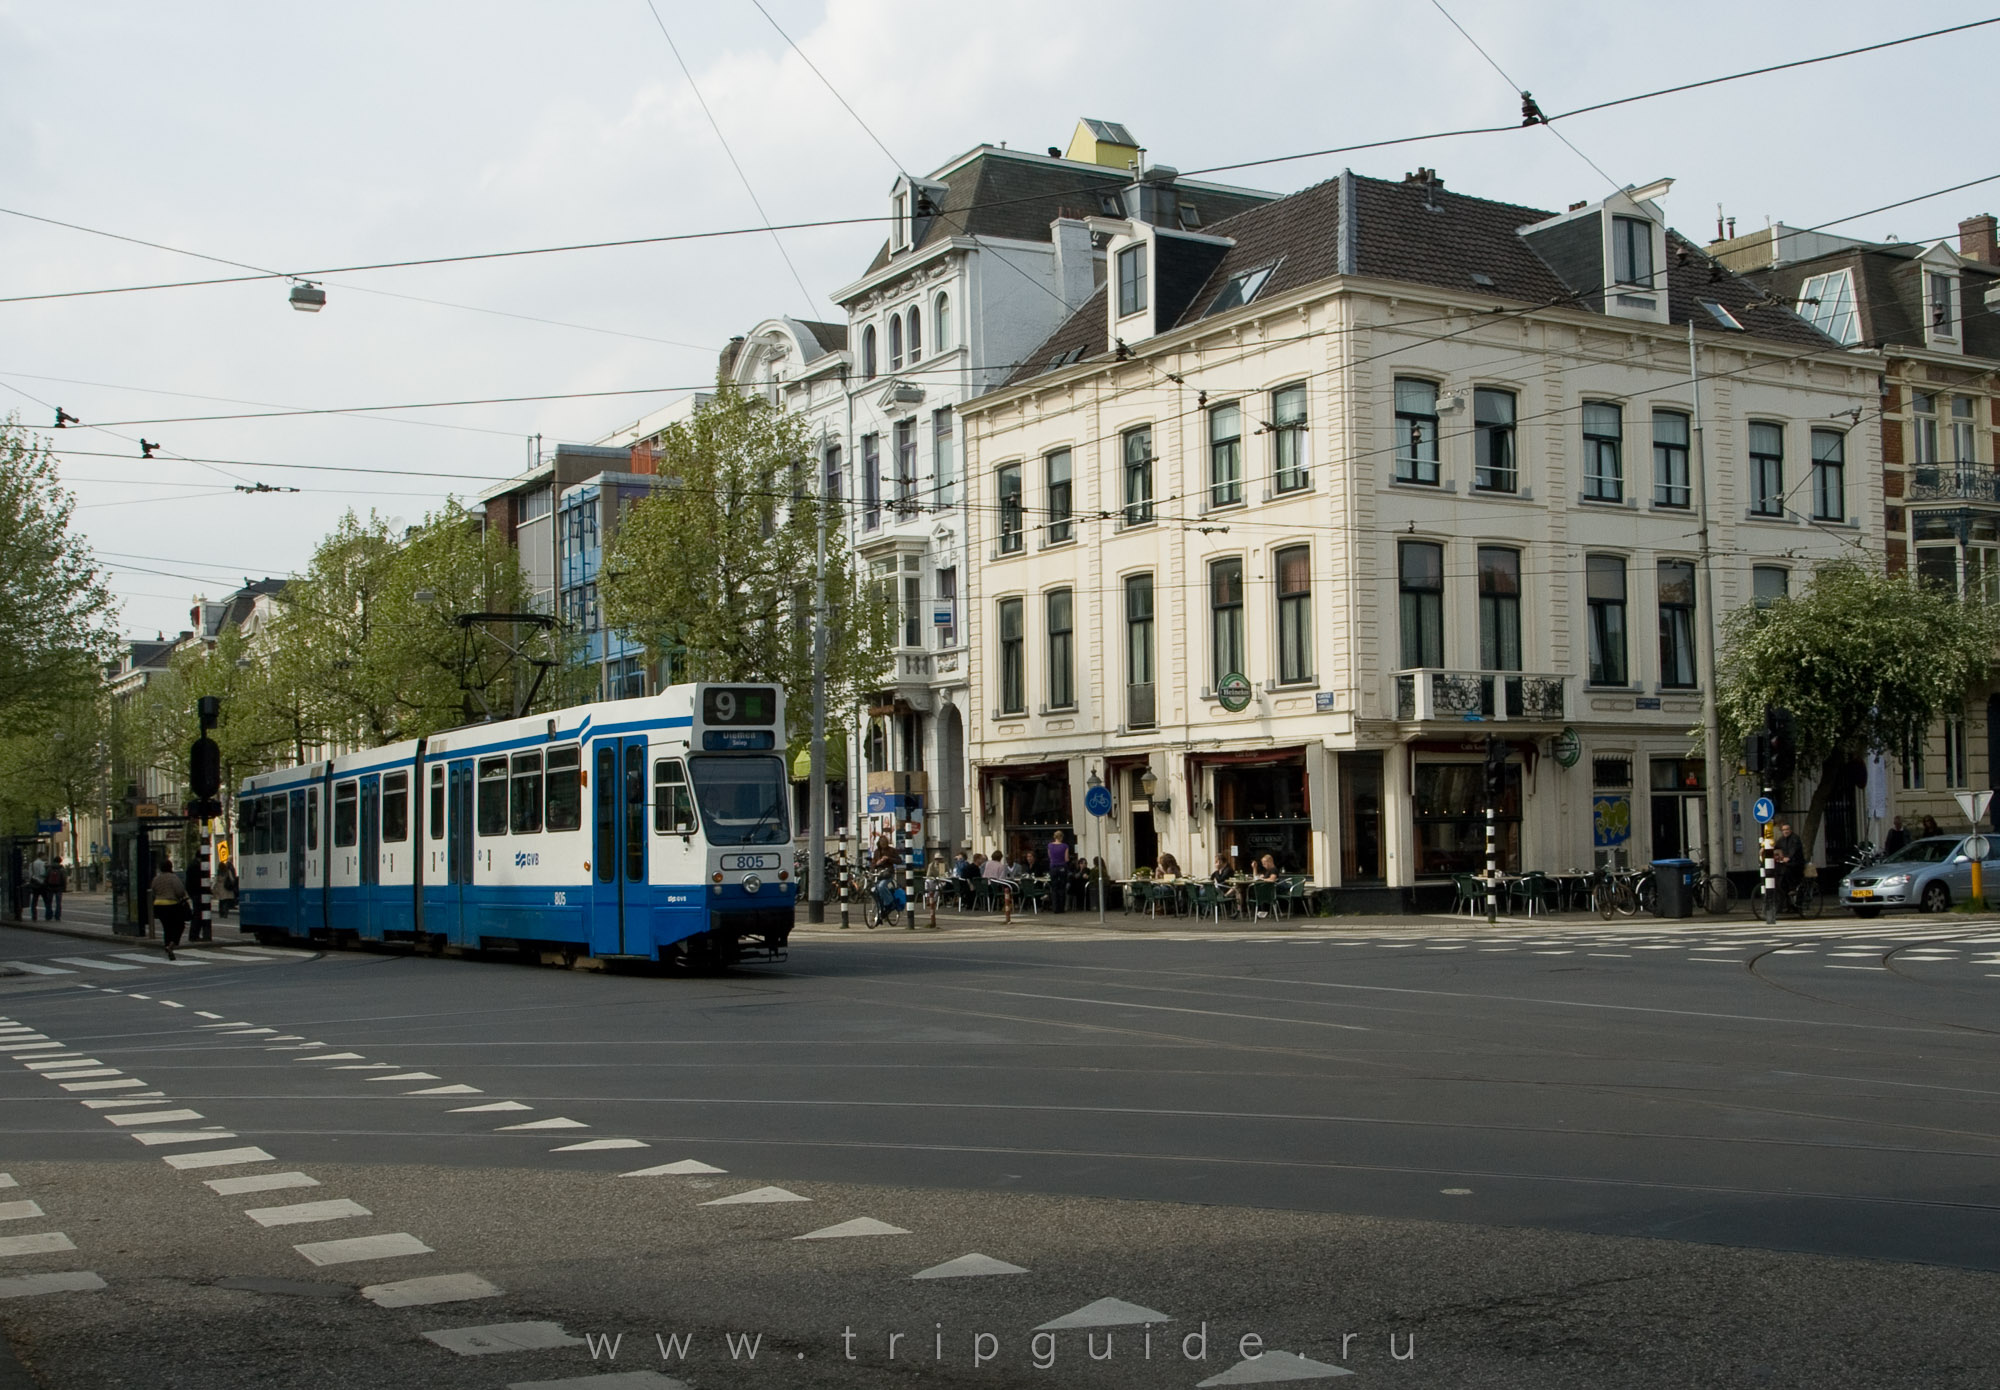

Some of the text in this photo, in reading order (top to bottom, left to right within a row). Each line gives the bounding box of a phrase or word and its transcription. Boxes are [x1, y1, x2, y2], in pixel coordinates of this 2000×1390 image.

[716, 691, 736, 721] 9
[527, 853, 540, 866] GVB
[737, 855, 764, 868] 805
[554, 891, 567, 906] 805
